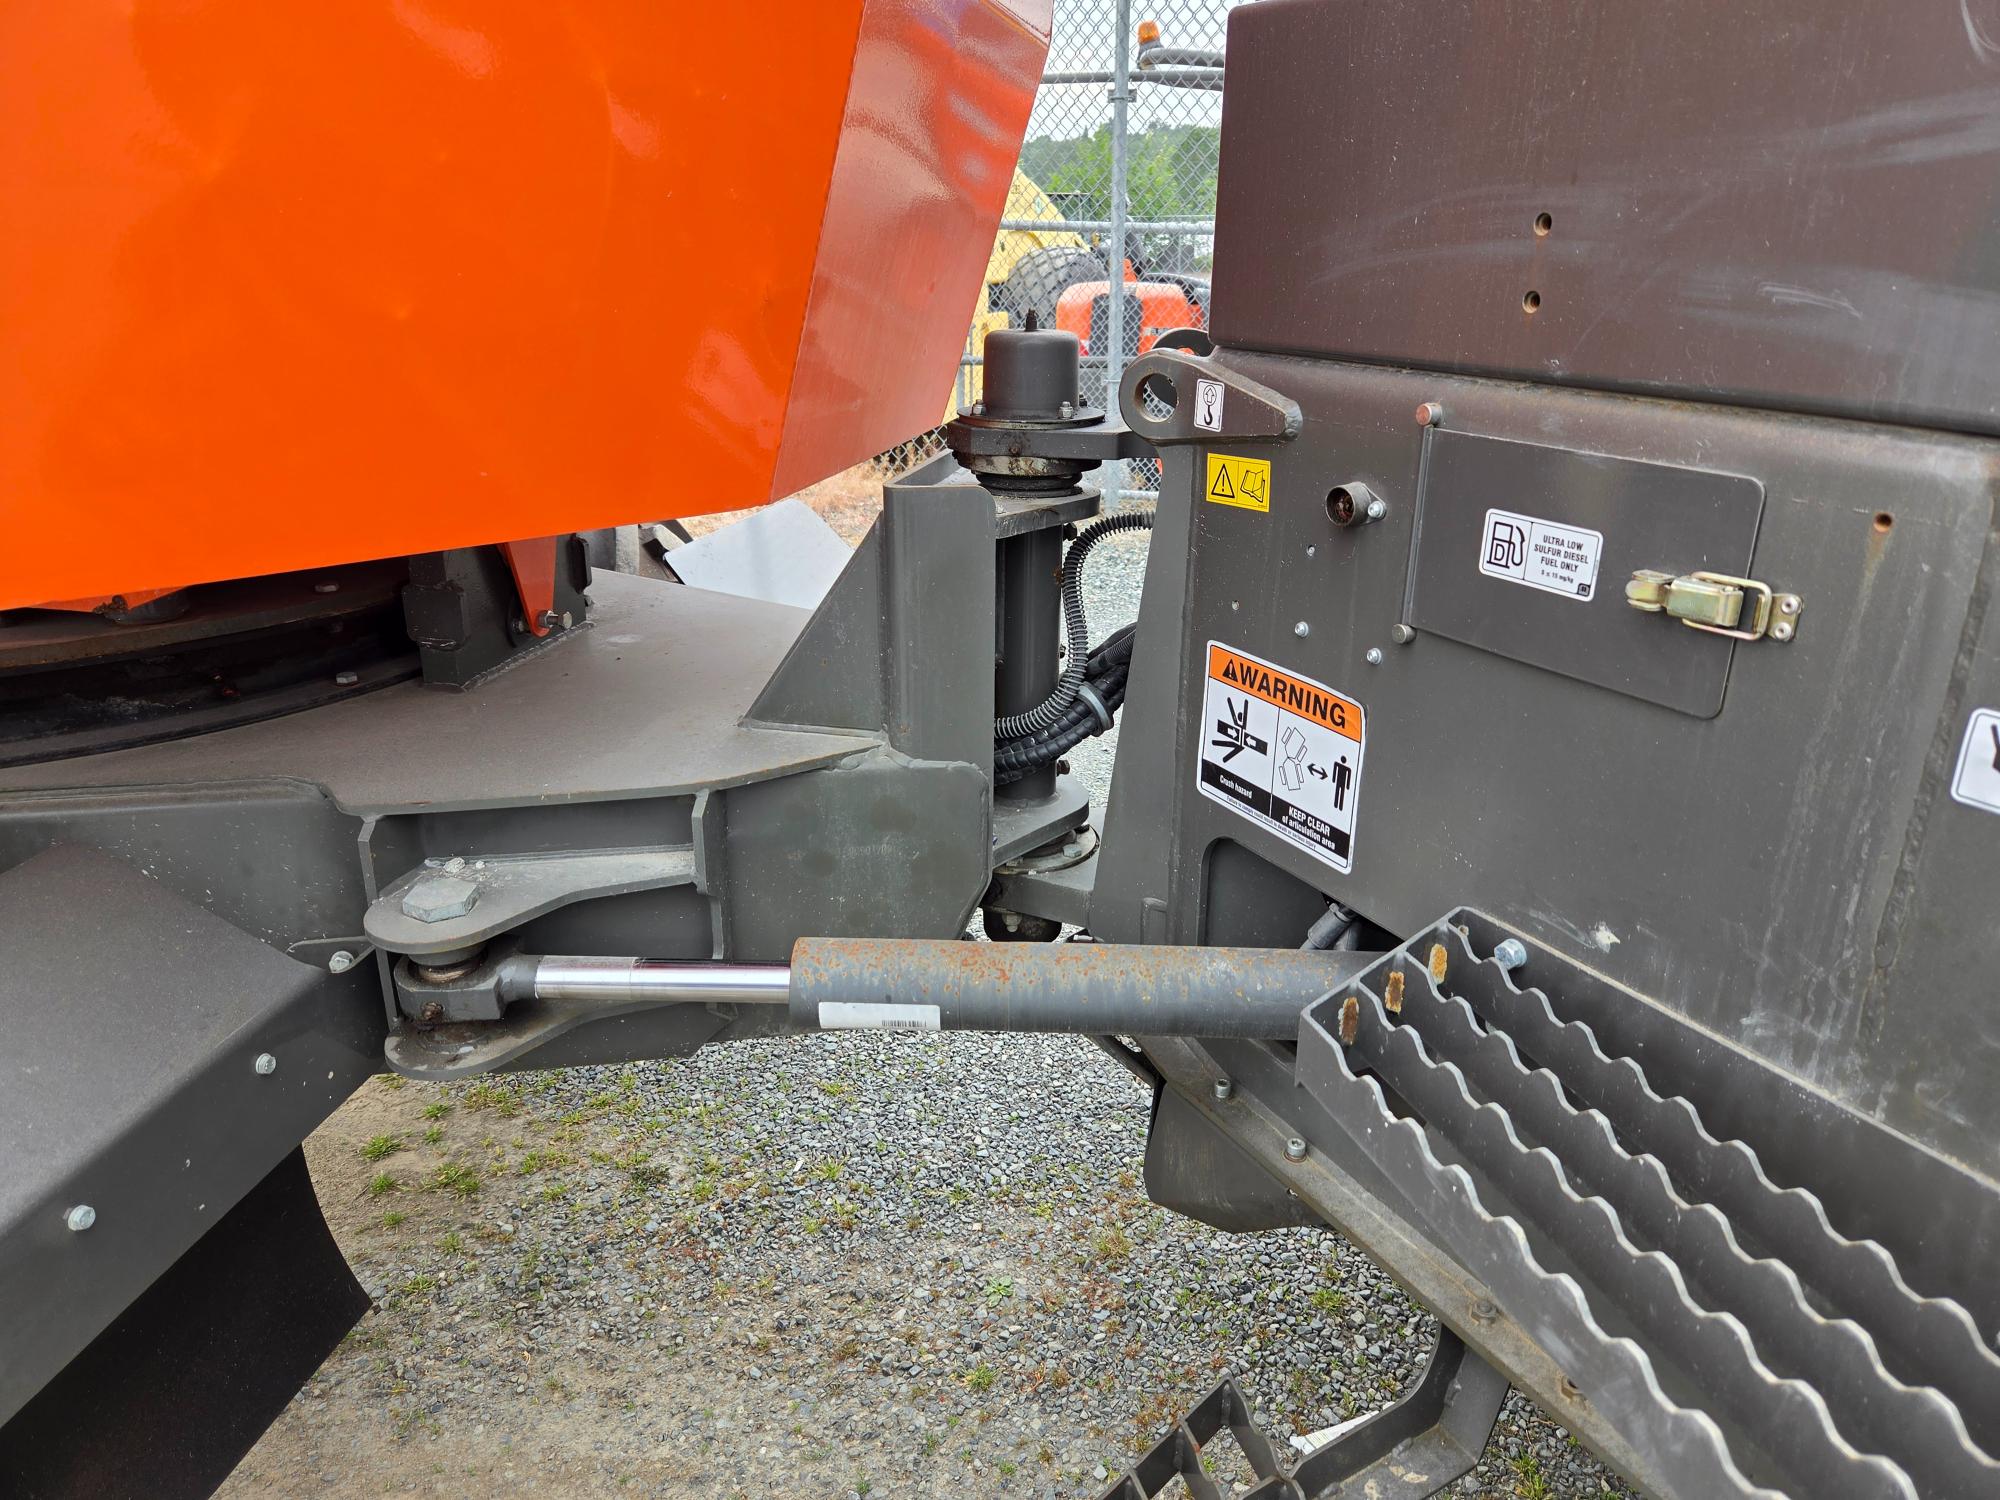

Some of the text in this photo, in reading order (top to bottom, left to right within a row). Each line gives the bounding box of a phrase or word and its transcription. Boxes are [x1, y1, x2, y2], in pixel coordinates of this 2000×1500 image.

[1494, 543, 1505, 561] D
[1543, 534, 1583, 551] ULTRA LOW
[1534, 544, 1588, 564] SULFUR DIESEL
[1541, 556, 1558, 568] FUEL
[1561, 561, 1579, 572] ONLY
[1240, 662, 1346, 729] WARNING
[1235, 782, 1252, 799] hazard
[1289, 806, 1330, 837] KEEP CLEAR
[1282, 815, 1335, 850] of articulation area
